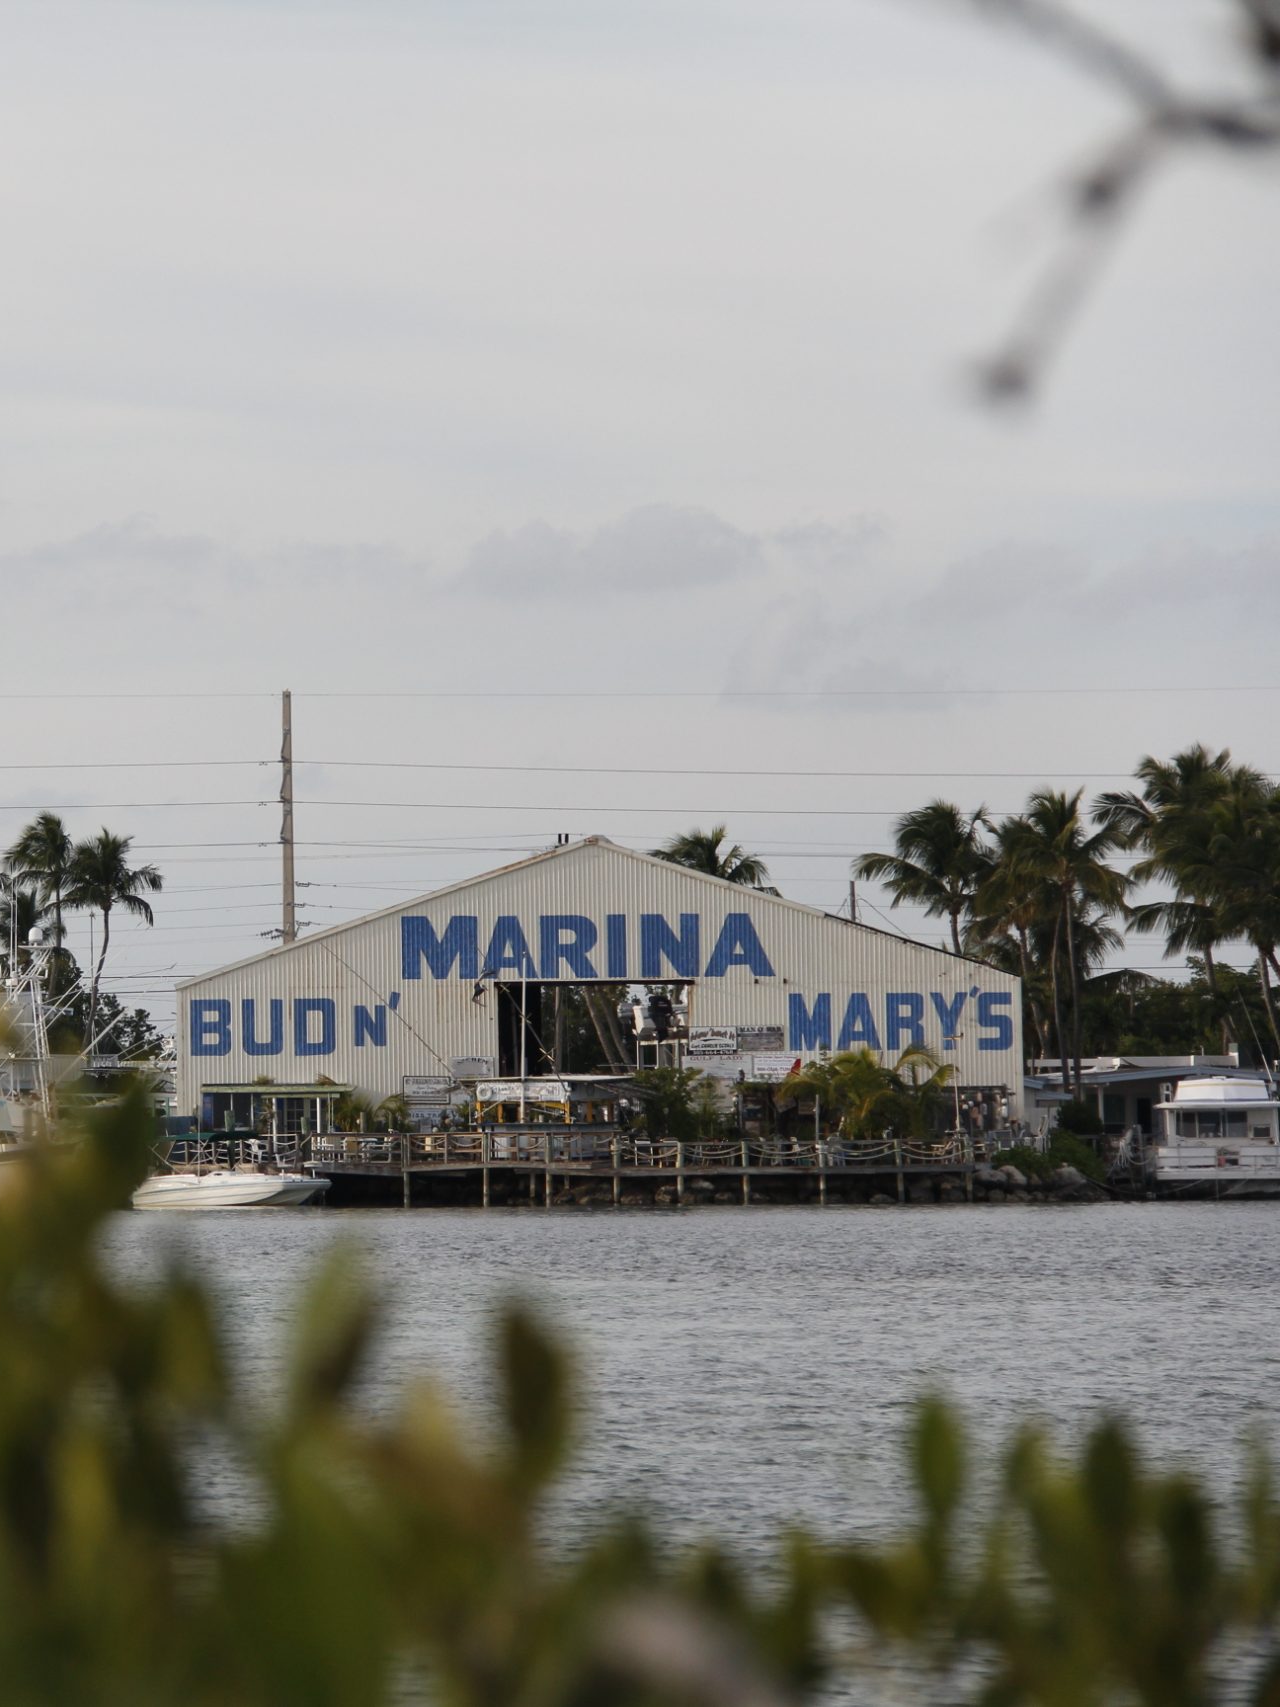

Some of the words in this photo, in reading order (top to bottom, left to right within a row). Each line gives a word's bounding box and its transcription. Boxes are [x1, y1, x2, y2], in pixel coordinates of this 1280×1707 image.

[401, 914, 776, 979] MARINA
[189, 998, 336, 1056] BUD
[788, 985, 1013, 1052] MARY'S
